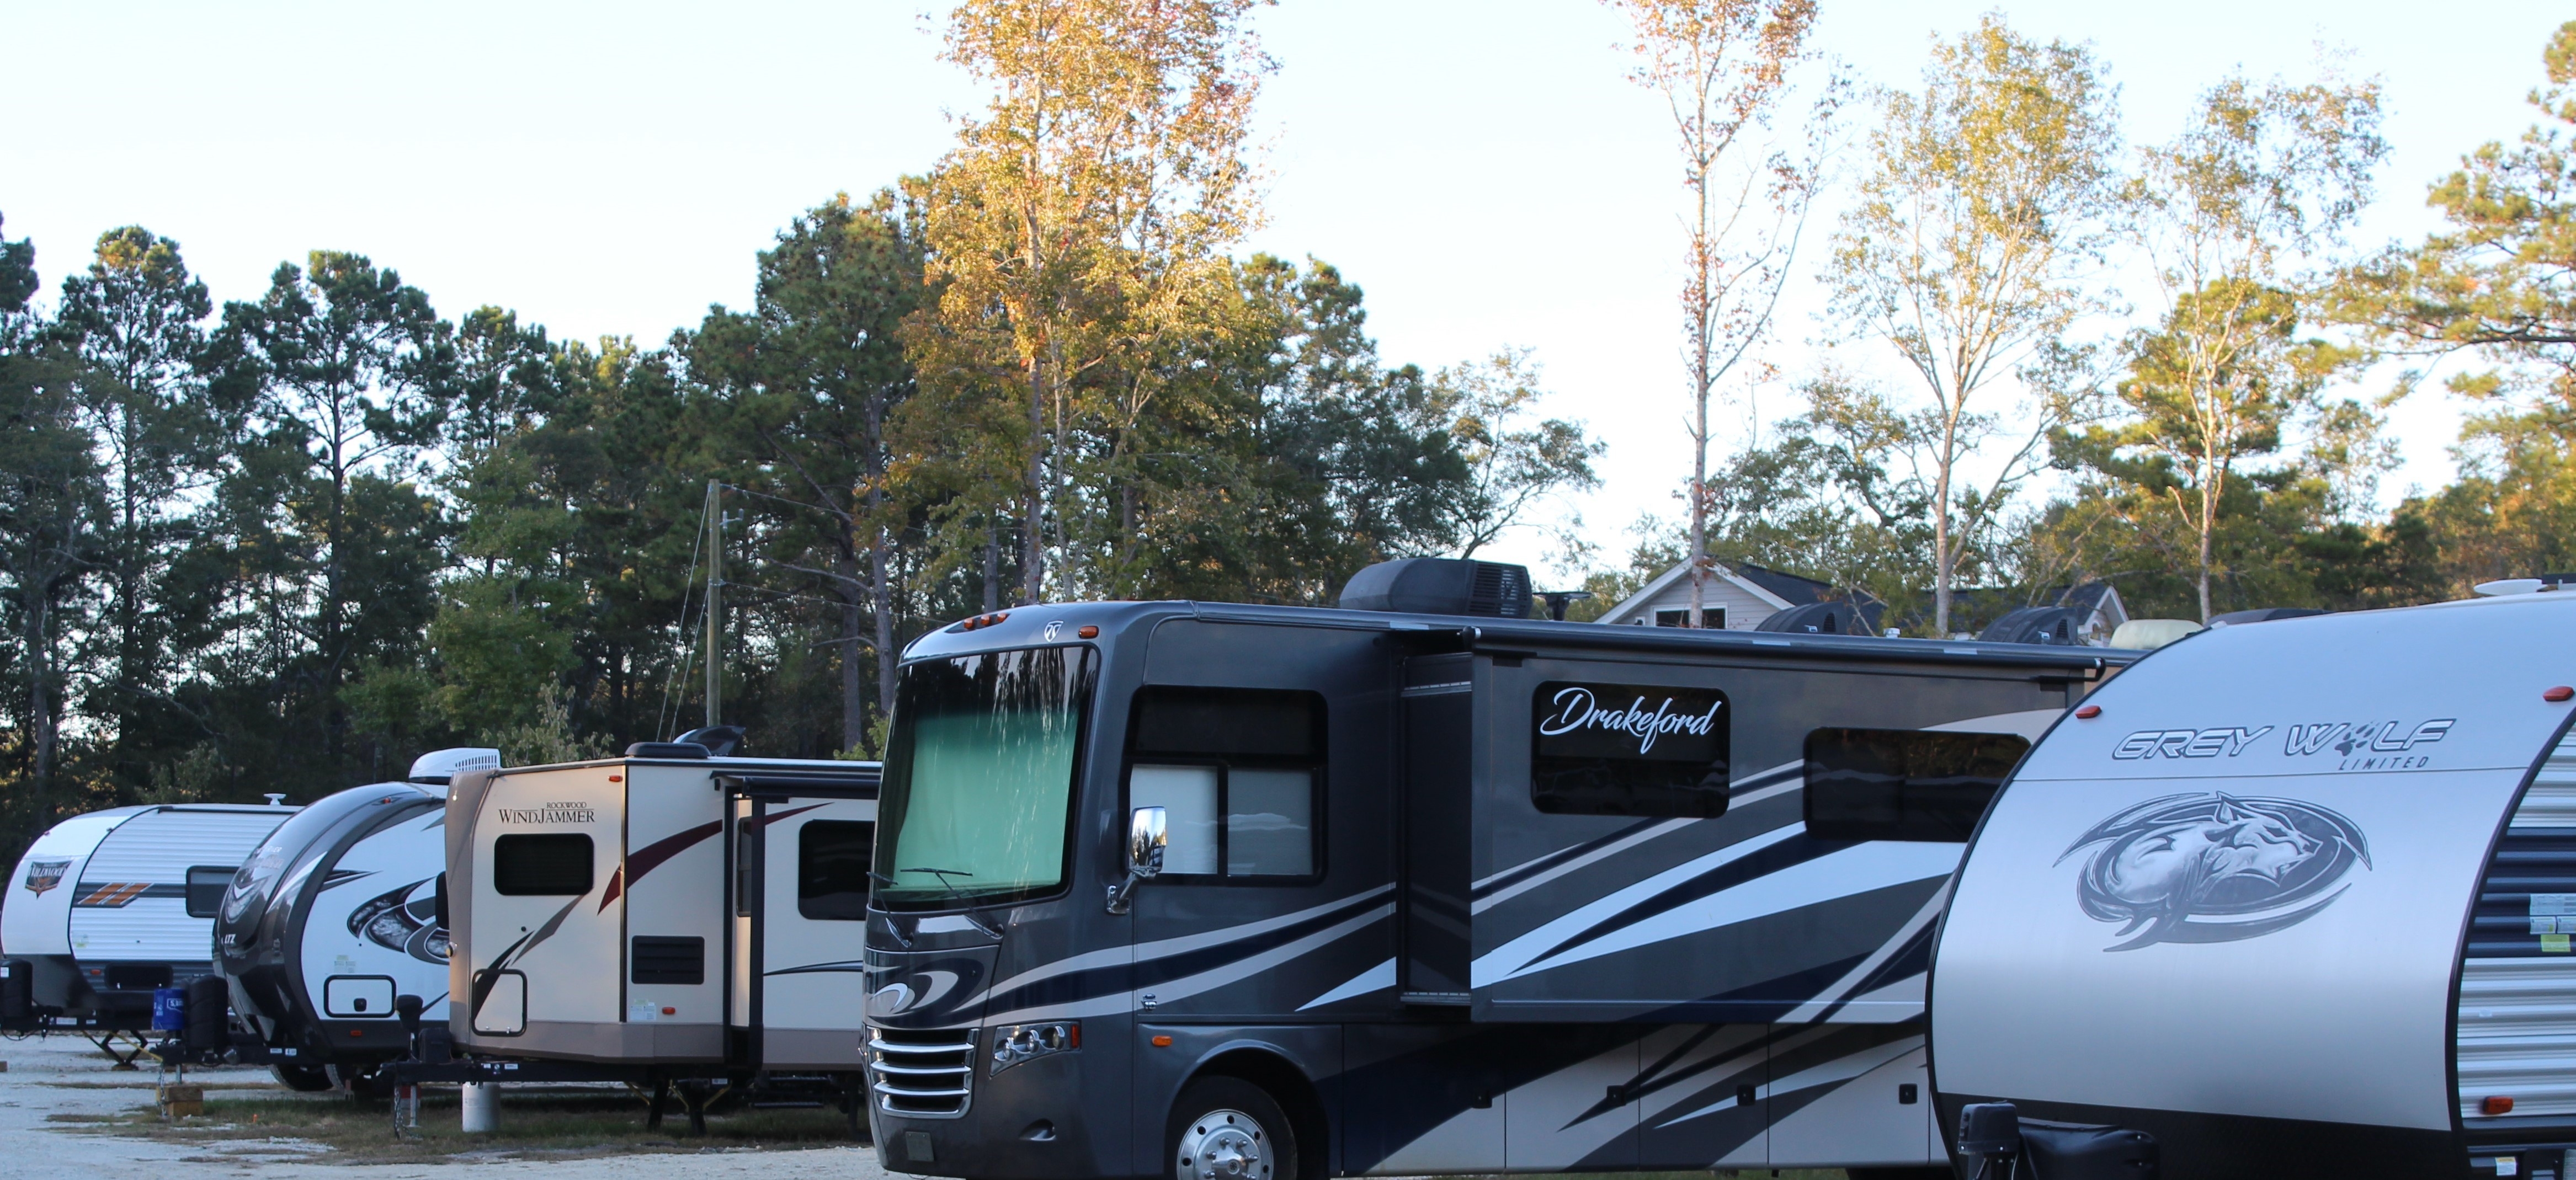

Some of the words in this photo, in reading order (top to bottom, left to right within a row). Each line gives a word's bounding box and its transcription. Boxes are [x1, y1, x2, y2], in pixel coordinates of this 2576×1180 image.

[1540, 687, 1722, 754] Drakeford
[2112, 725, 2274, 760] GREY
[2339, 756, 2429, 771] LIMITED
